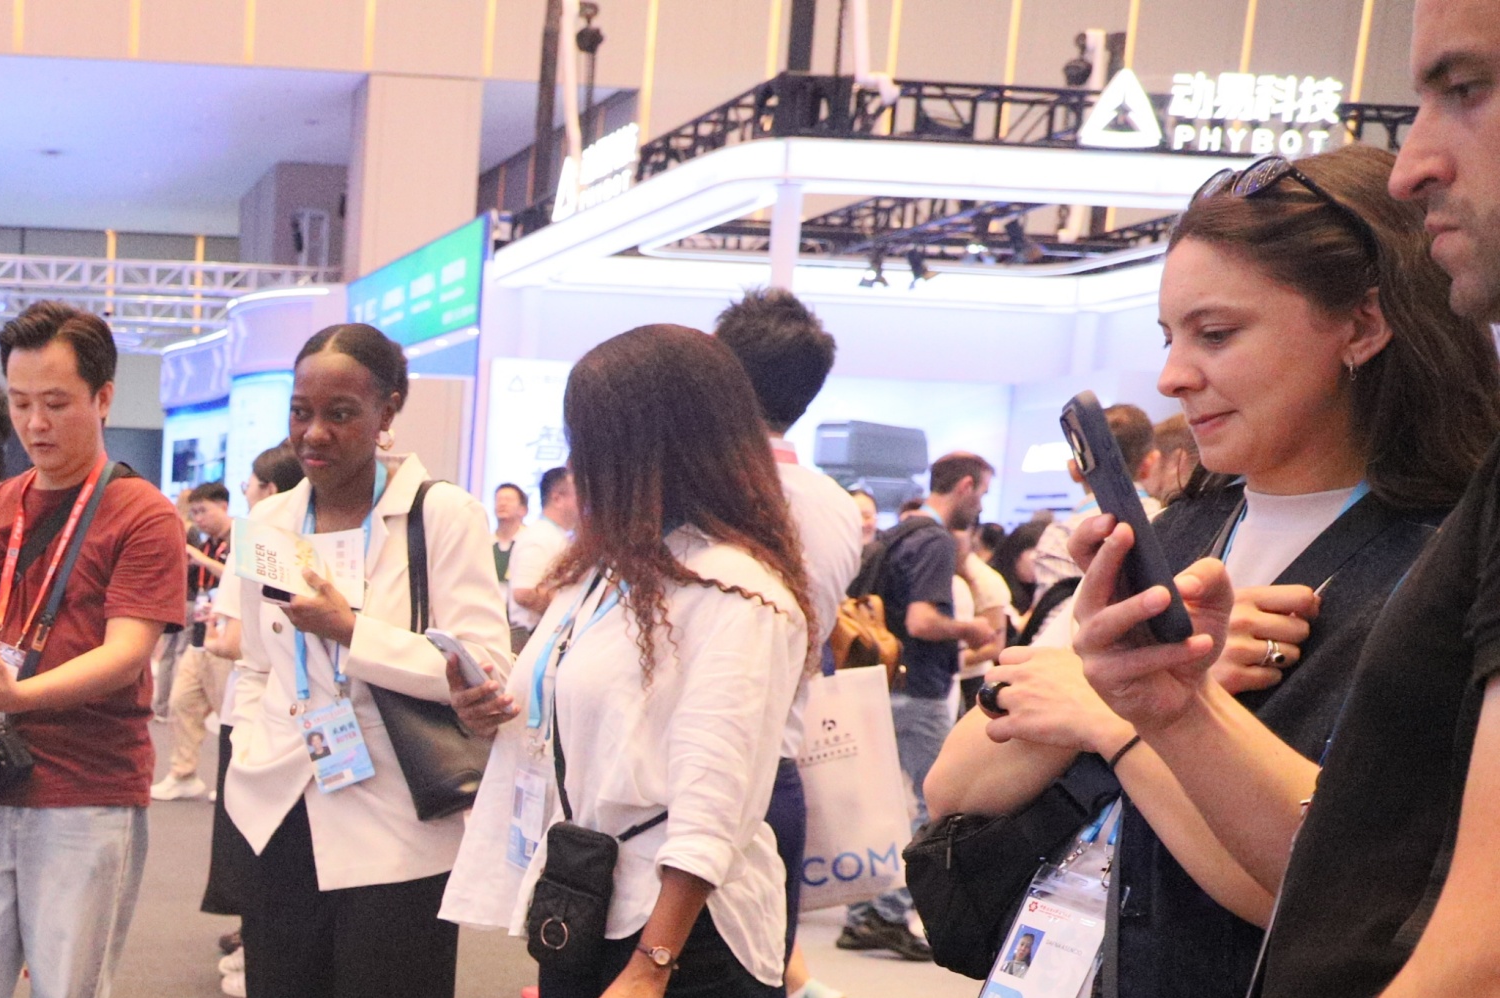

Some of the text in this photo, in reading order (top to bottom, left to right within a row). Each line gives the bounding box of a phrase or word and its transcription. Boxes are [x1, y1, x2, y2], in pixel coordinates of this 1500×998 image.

[1172, 124, 1330, 154] PHYBOT
[254, 542, 267, 577] BUYER
[266, 549, 278, 581] GUIDE
[802, 842, 900, 887] COM
